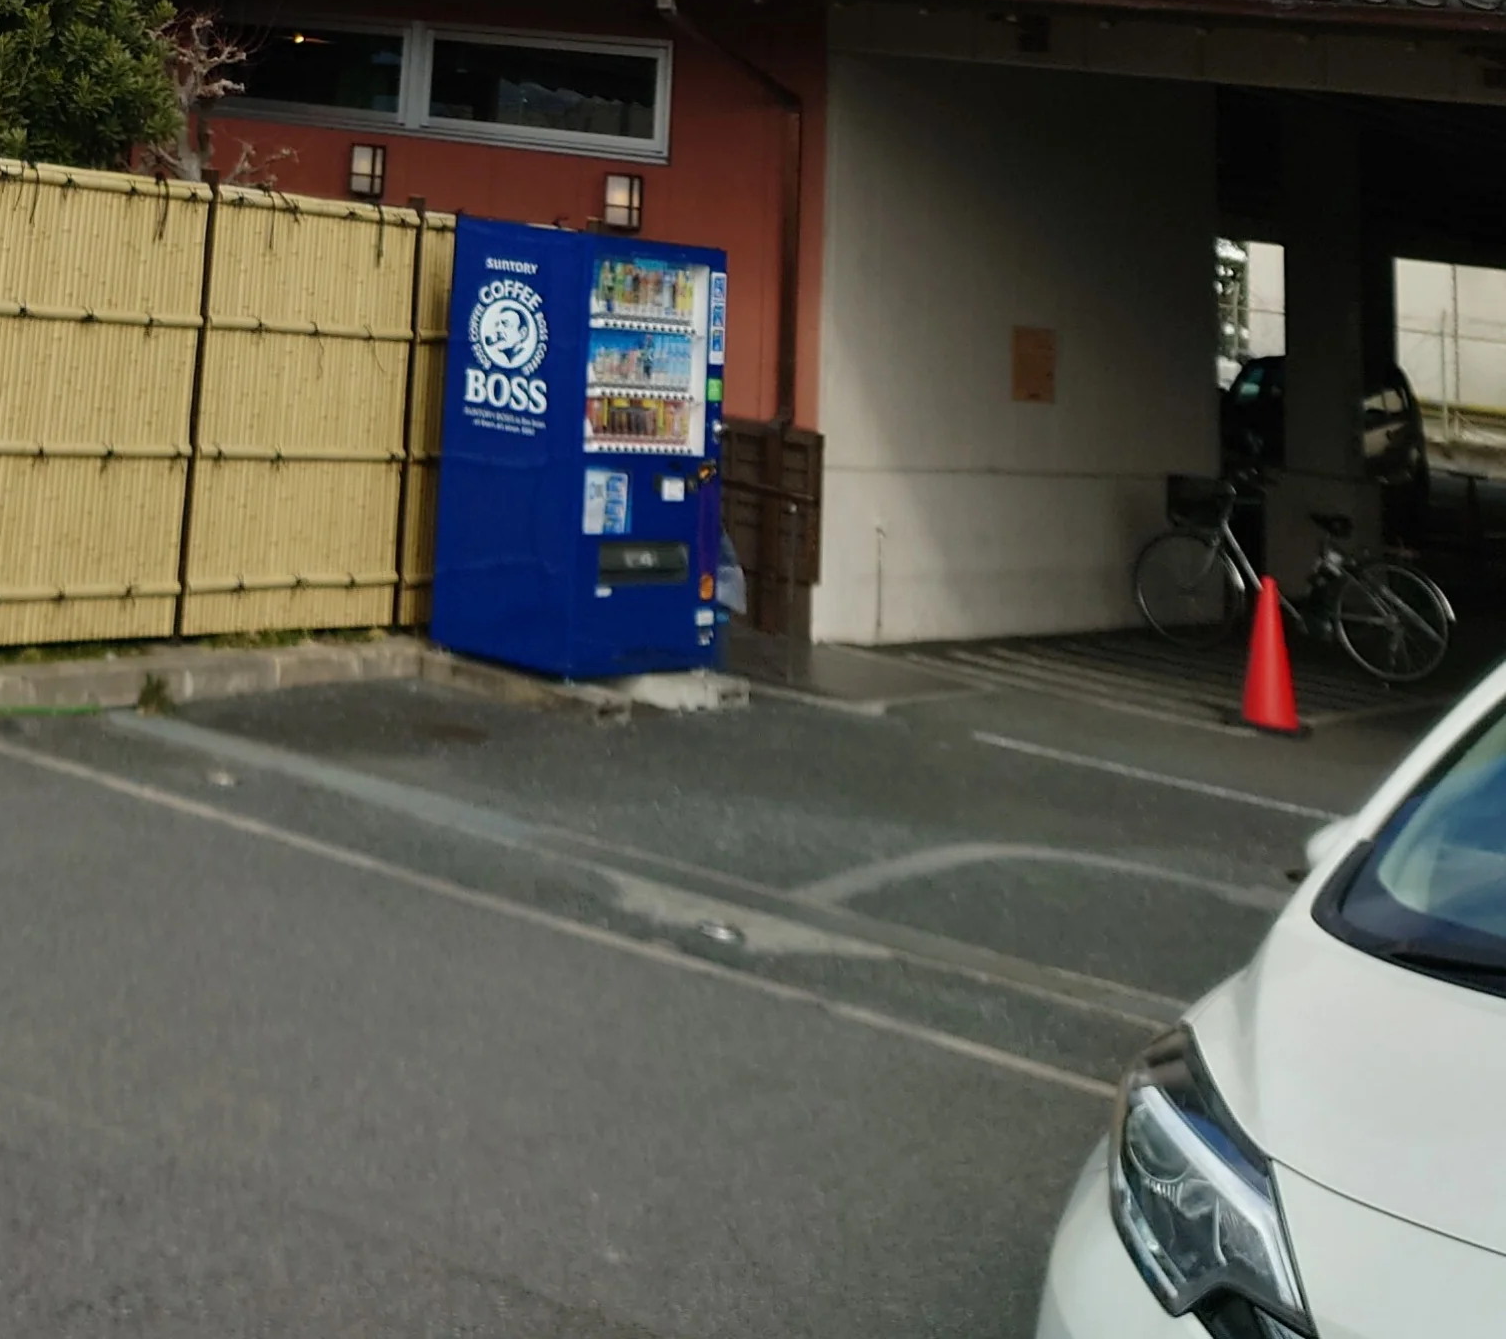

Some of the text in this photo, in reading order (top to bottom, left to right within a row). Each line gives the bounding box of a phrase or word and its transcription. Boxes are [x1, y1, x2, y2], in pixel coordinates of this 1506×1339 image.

[485, 257, 538, 275] SUNTORY
[478, 279, 543, 312] COFFEE
[463, 368, 547, 415] BOSS
